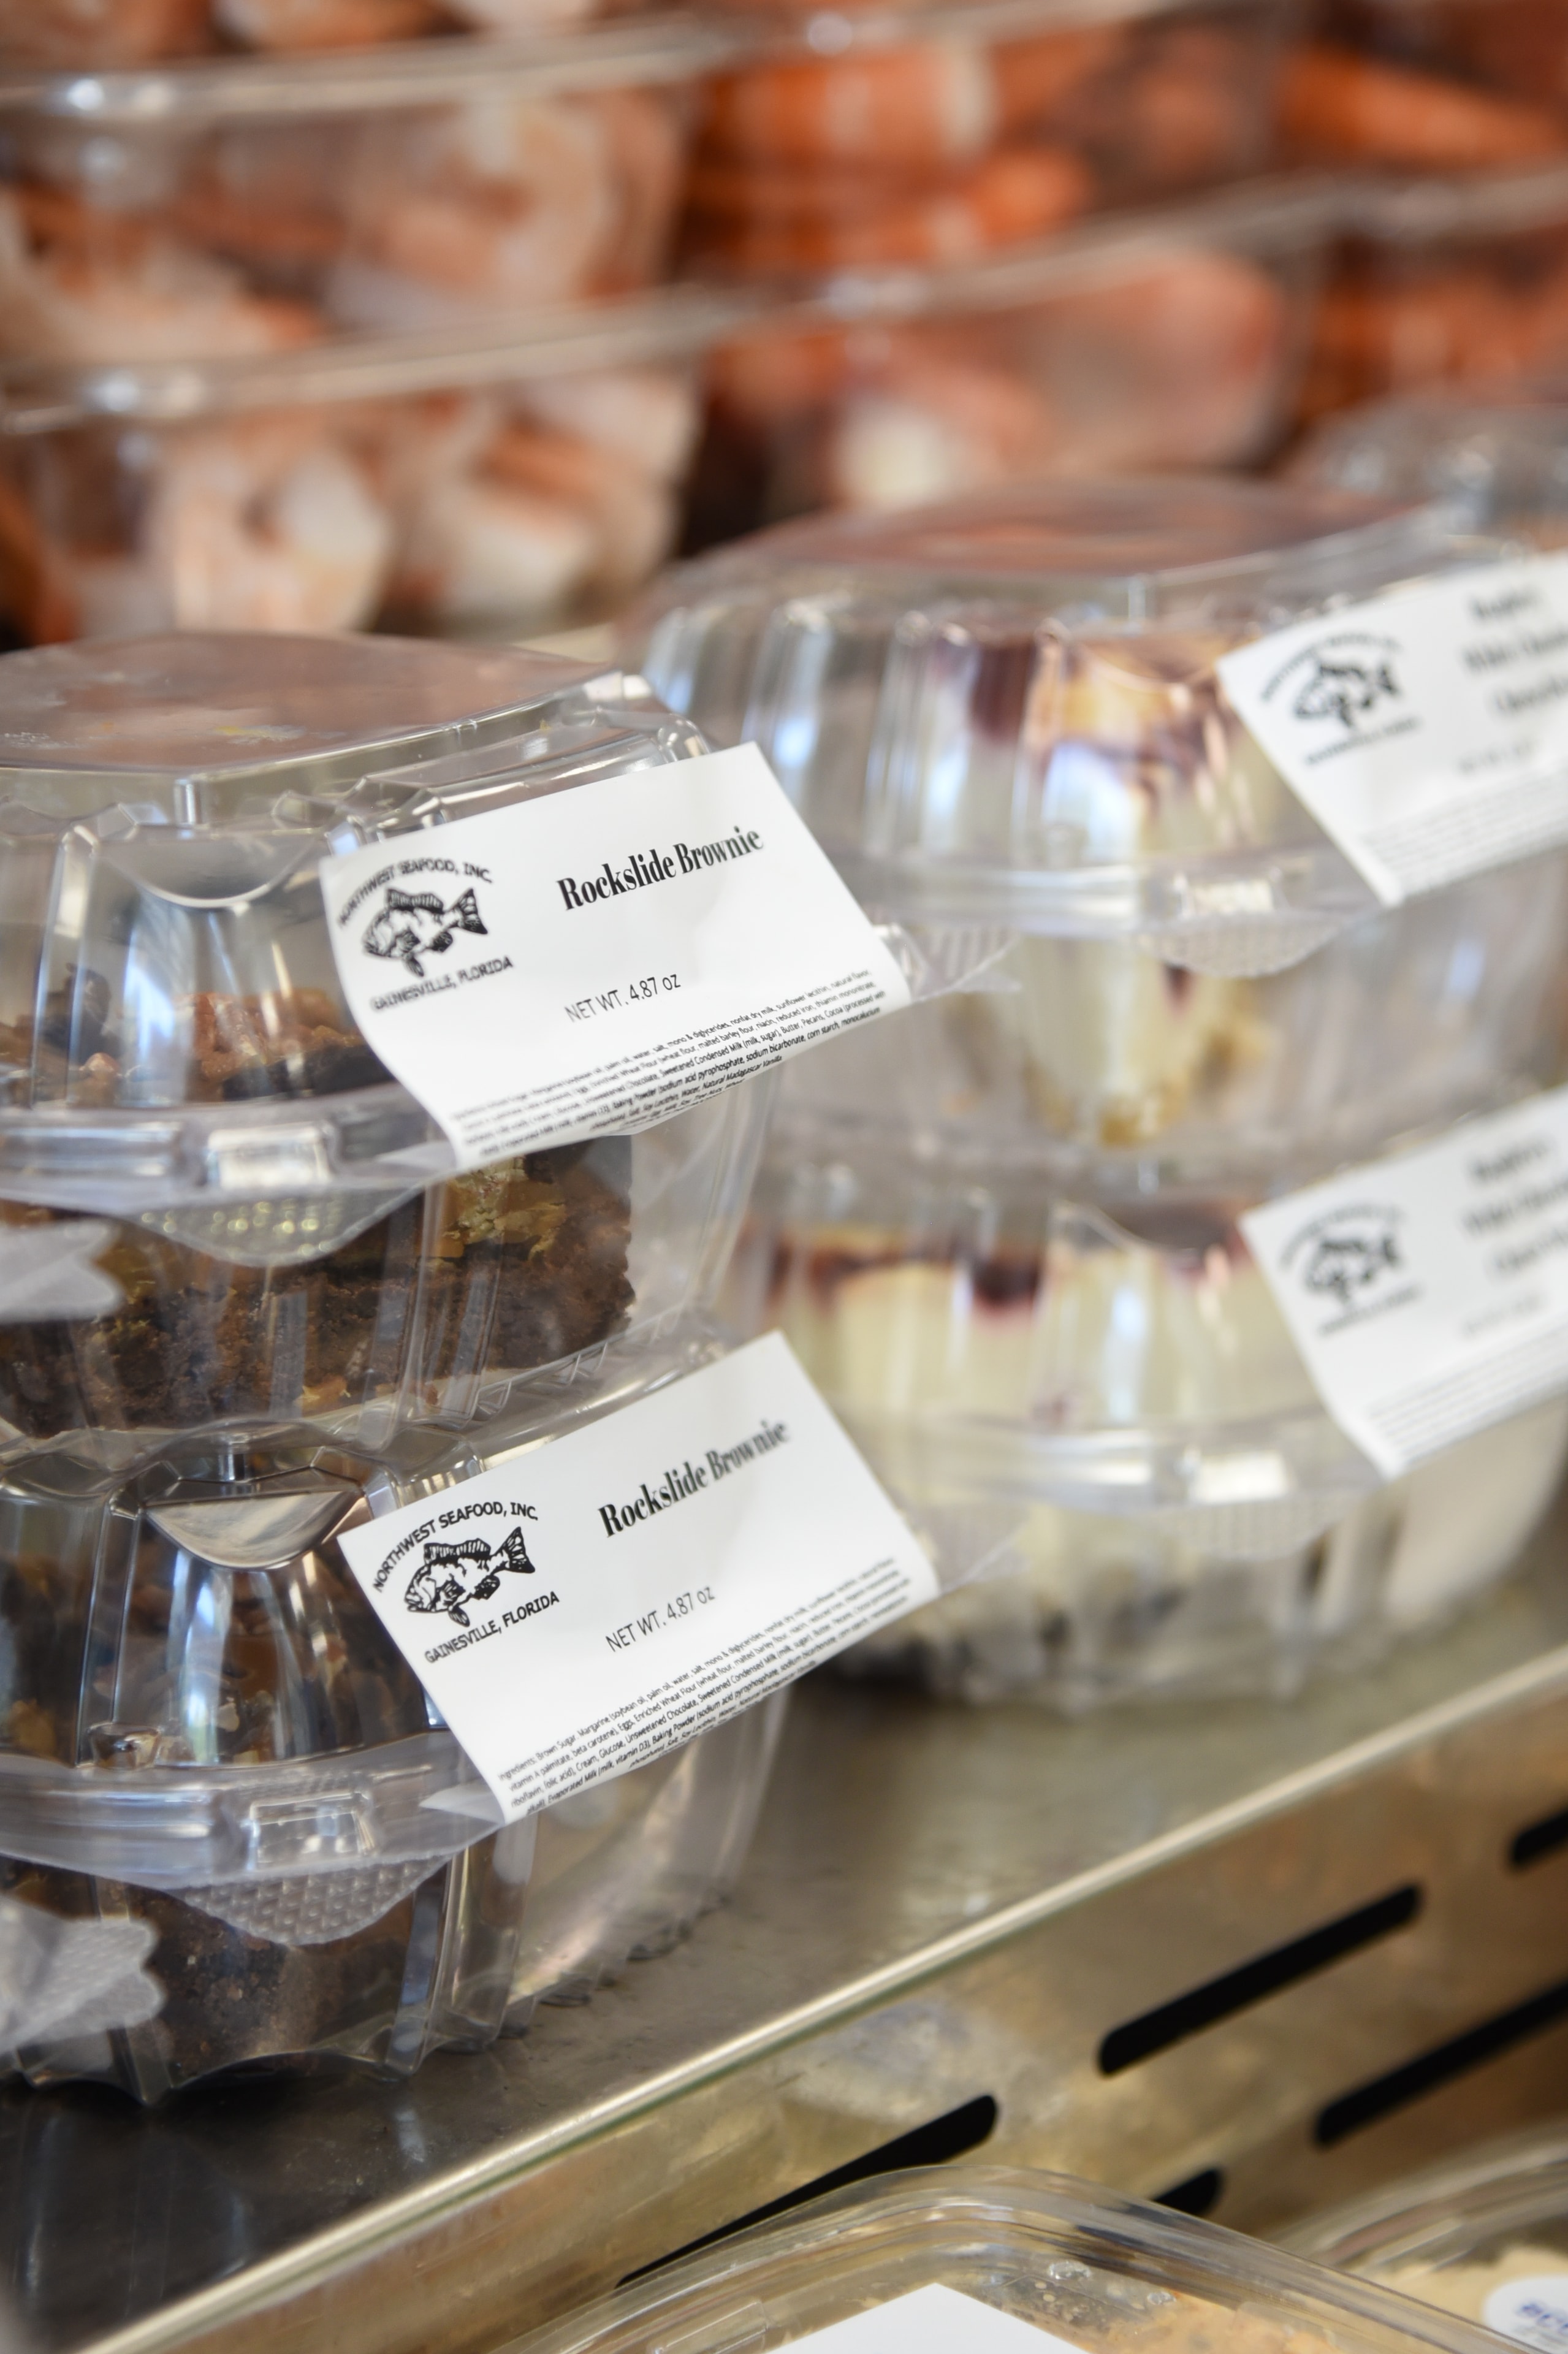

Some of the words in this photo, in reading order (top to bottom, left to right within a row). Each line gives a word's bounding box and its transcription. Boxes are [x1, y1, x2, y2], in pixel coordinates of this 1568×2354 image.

[338, 865, 395, 926] NORTHWEST
[557, 848, 676, 910] Rockslide
[672, 826, 763, 874] Brownie
[370, 973, 457, 1011] GAINESVILLE,
[459, 955, 514, 981] FLORIDA
[564, 998, 596, 1023] NET
[595, 989, 629, 1012] WT.
[630, 976, 658, 1001] 4.87
[662, 973, 681, 991] oz
[666, 1037, 687, 1046] mono
[692, 1022, 731, 1038] diglycerides,
[729, 1015, 752, 1025] nonfat
[760, 1006, 777, 1015] milk,
[775, 994, 805, 1010] sunflower
[805, 985, 831, 997] lecithin,
[830, 975, 853, 988] natural
[659, 1058, 695, 1077] Sweetened
[693, 1046, 729, 1065] Condensed
[728, 1042, 743, 1051] Milk
[742, 1035, 761, 1049] (milk,
[759, 1029, 782, 1042] sugar),
[779, 1022, 803, 1034] Butter,
[800, 1013, 826, 1026] Pecans,
[823, 1006, 844, 1018] Cocoa
[843, 994, 873, 1012] (processed
[684, 1072, 697, 1084] acid
[698, 1056, 745, 1081] pyrophosphate,
[745, 1048, 769, 1062] sodium
[768, 1034, 806, 1053] bicarbonate,
[806, 1029, 821, 1040] corn
[820, 1021, 840, 1035] starch,
[698, 1035, 721, 1048] malted
[718, 1030, 740, 1042] barley
[737, 1025, 758, 1034] flour,
[755, 1018, 777, 1029] niacin,
[775, 1008, 801, 1022] reduced
[799, 1004, 816, 1013] iron,
[815, 995, 839, 1007] thiamin
[702, 1075, 726, 1089] Natural
[724, 1063, 762, 1081] Madagascar
[597, 1461, 709, 1538] Rockslide
[705, 1420, 788, 1482] Brownie
[372, 1519, 436, 1593] NORTHWEST
[438, 1502, 507, 1529] SEAFOOD,
[424, 1620, 502, 1664] GAINESVILLE,
[502, 1591, 560, 1628] FLORIDA
[605, 1623, 636, 1653] NET
[637, 1610, 667, 1636] WT.
[667, 1592, 695, 1620] 4.87
[696, 1586, 716, 1604] oz
[498, 1757, 536, 1780] Ingredients:
[535, 1745, 558, 1761] Brown
[577, 1716, 611, 1737] Margarine
[608, 1701, 637, 1720] (soybean
[645, 1688, 663, 1701] palm
[704, 1655, 723, 1667] mono
[510, 1774, 534, 1791] vitamin
[533, 1770, 541, 1778] A
[539, 1754, 573, 1776] palmitate,
[571, 1744, 588, 1757] beta
[617, 1719, 636, 1731] Eggs,
[633, 1702, 662, 1722] Enriched
[659, 1691, 682, 1707] Wheat
[679, 1683, 697, 1696] Flour
[695, 1671, 718, 1688] (wheat
[715, 1663, 735, 1675] flour,
[733, 1650, 755, 1666] malted
[753, 1640, 774, 1654] barley
[543, 1777, 558, 1789] folic
[575, 1754, 599, 1772] Cream,
[598, 1740, 626, 1759] Glucose,
[625, 1715, 667, 1743] Unsweetened
[666, 1699, 699, 1720] Chocolate,
[697, 1678, 731, 1702] Sweetened
[730, 1659, 764, 1683] Condensed
[763, 1653, 777, 1664] Milk
[584, 1769, 597, 1782] Milk
[615, 1747, 638, 1765] vitamin
[652, 1727, 672, 1745] Baking
[672, 1714, 695, 1732] Powder
[696, 1701, 720, 1721] (sodium
[721, 1691, 734, 1705] acid
